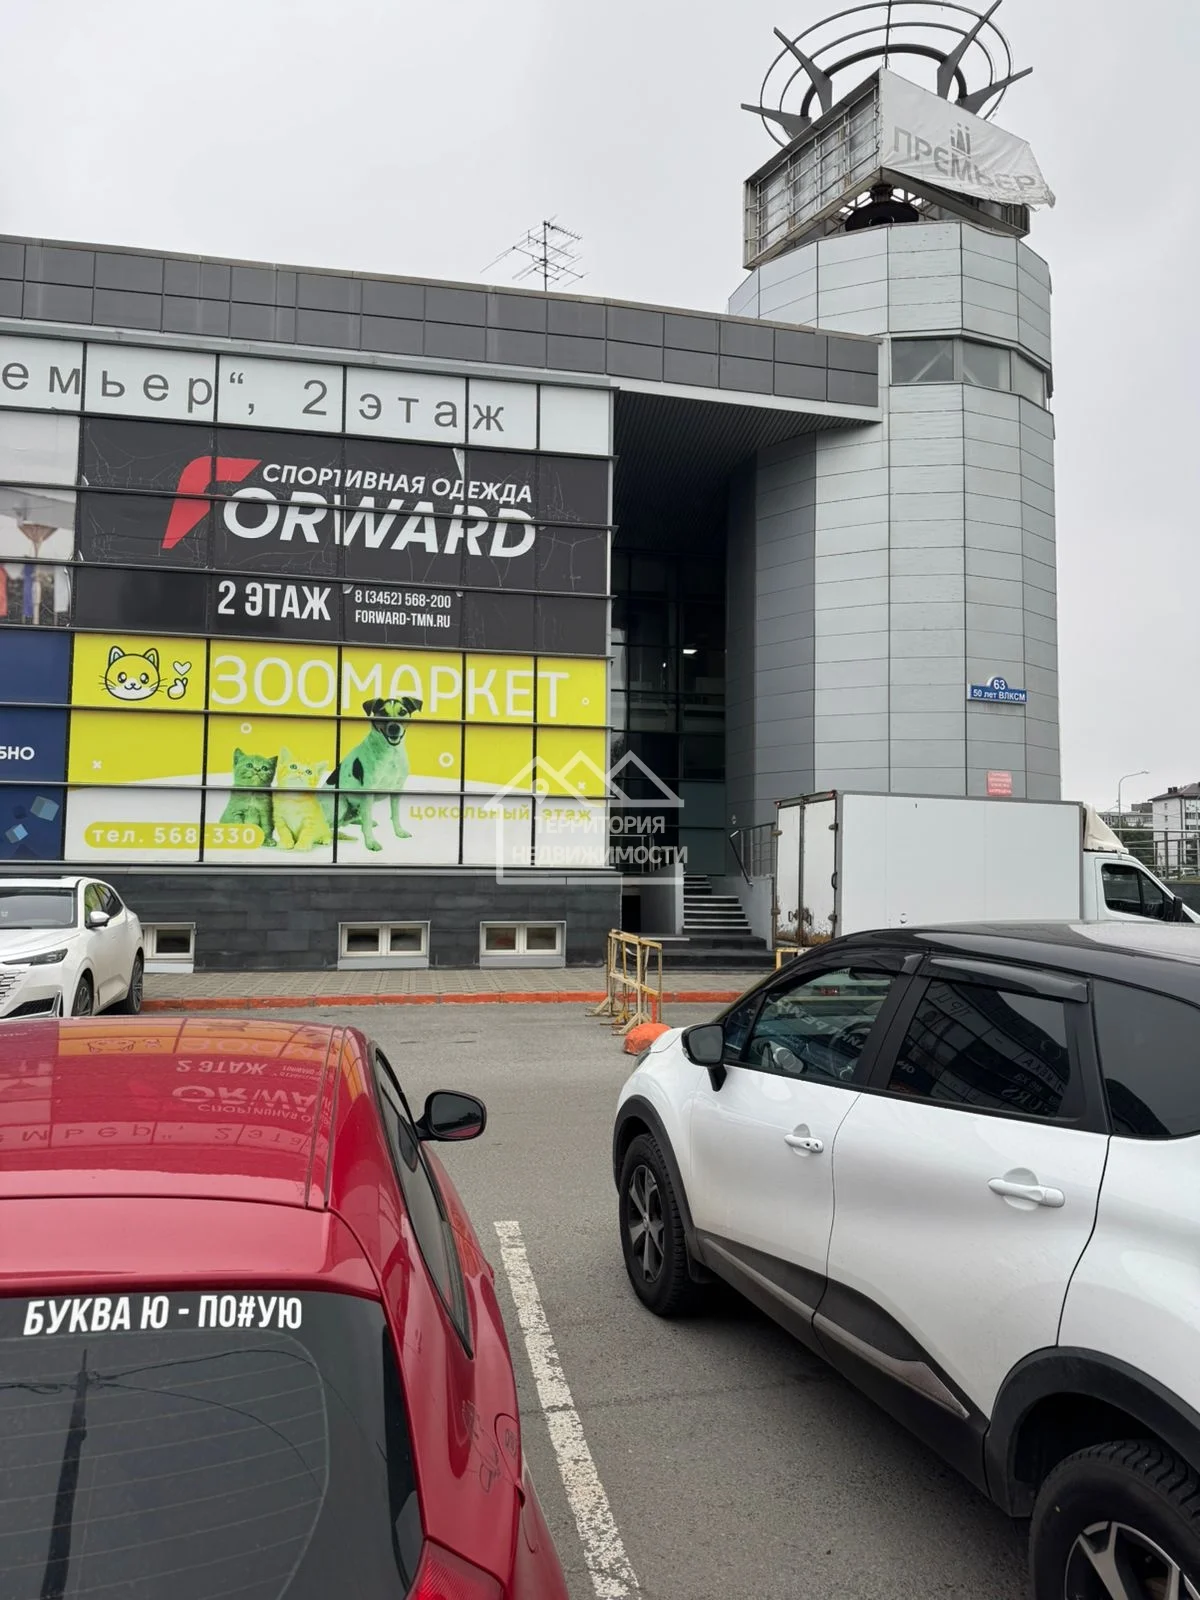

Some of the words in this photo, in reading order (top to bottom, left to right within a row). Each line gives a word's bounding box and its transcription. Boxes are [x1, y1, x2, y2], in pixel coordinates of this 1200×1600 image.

[894, 126, 1036, 190] ПРЕМЬЕР
[302, 380, 328, 415] 2
[358, 393, 505, 432] этаж
[262, 463, 426, 494] СПОРТИВНАЯ
[431, 477, 533, 503] ОДЕЖДА
[161, 455, 536, 558] FORWARD
[217, 580, 236, 615] 2
[244, 582, 332, 621] ЭТАЖ
[354, 590, 362, 603] 8
[365, 590, 402, 606] (3452)
[404, 592, 452, 609] 568-200
[354, 609, 451, 628] FORWARD-TMN.RU
[211, 655, 571, 718] ЗООМАРКЕТ
[973, 689, 983, 698] 50
[998, 691, 1026, 701] ВЛКСМ
[993, 679, 1006, 690] 63
[92, 827, 144, 844] тел.
[23, 1296, 131, 1336] БУКВА
[140, 1295, 170, 1330] Ю
[198, 1294, 302, 1330] ПО#УЮ
